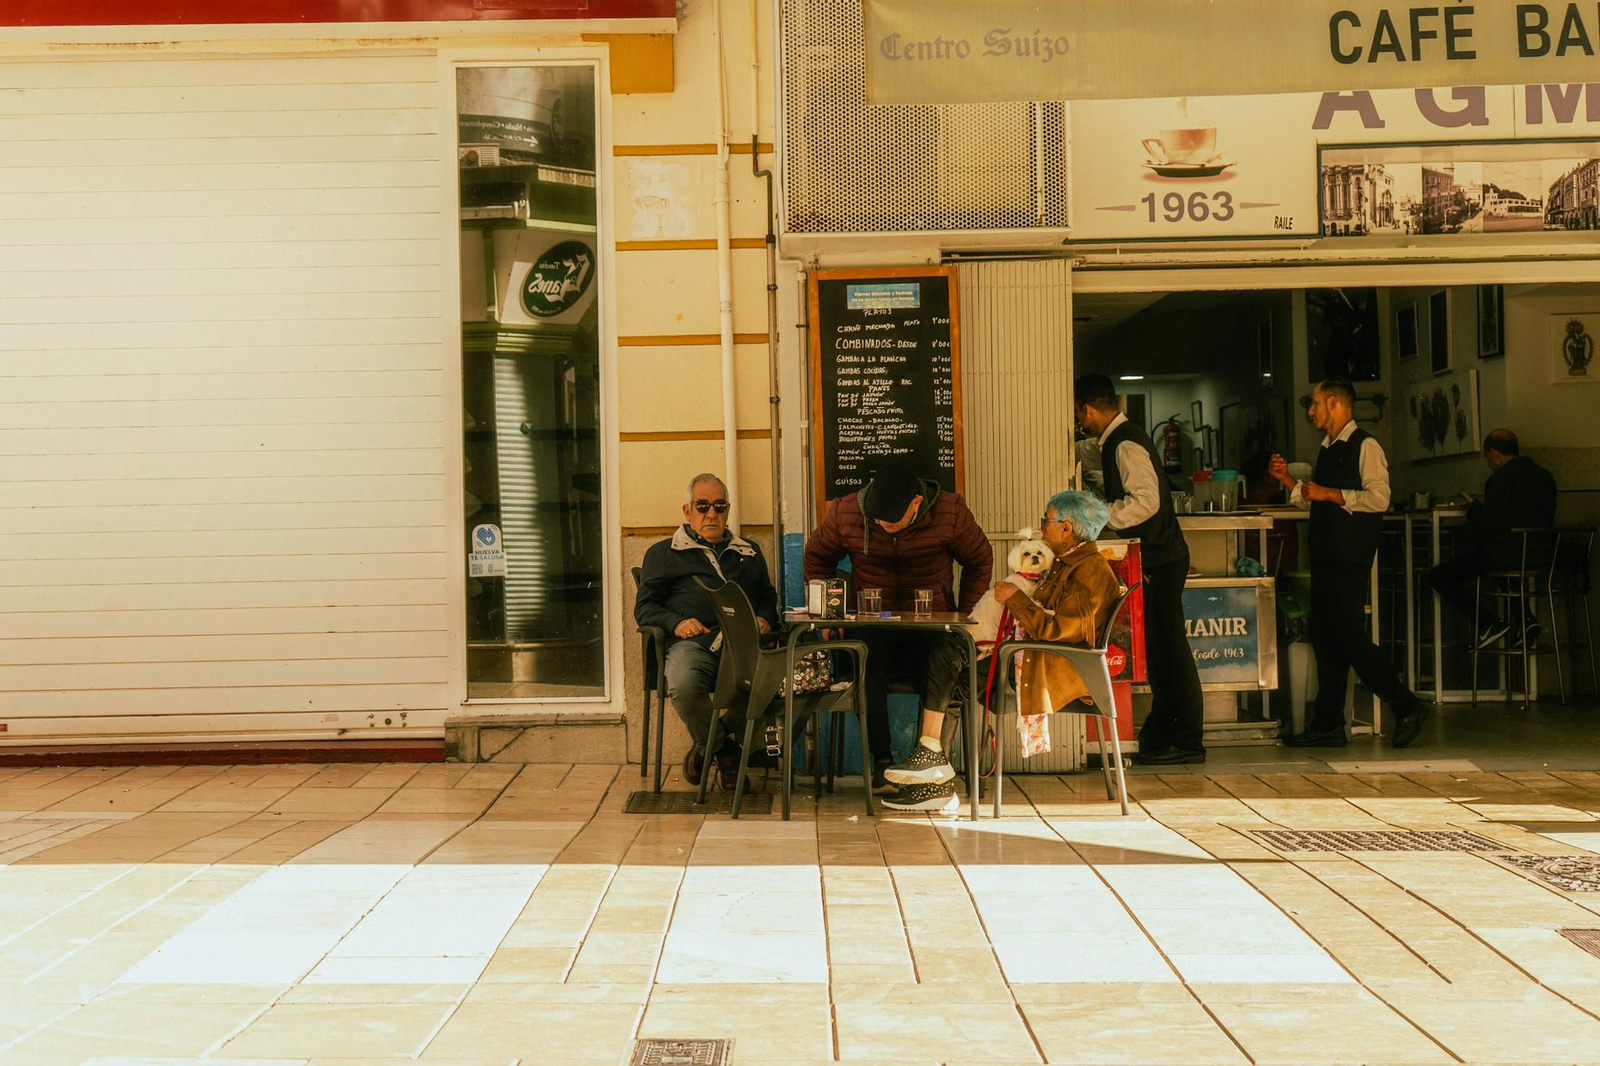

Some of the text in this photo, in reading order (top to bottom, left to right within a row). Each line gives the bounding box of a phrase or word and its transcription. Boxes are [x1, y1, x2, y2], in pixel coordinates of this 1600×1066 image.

[1329, 0, 1600, 64] CAFÉ BA
[880, 27, 1069, 63] Centro Suizo
[1141, 191, 1234, 222] 1963
[1274, 216, 1293, 230] RAILE
[898, 341, 918, 349] DESDE
[836, 354, 860, 363] GAMBAS
[836, 367, 861, 375] GAMBAS
[837, 378, 861, 386] GAMBAS
[835, 477, 863, 486] GUISOS
[1224, 647, 1245, 658] 1963
